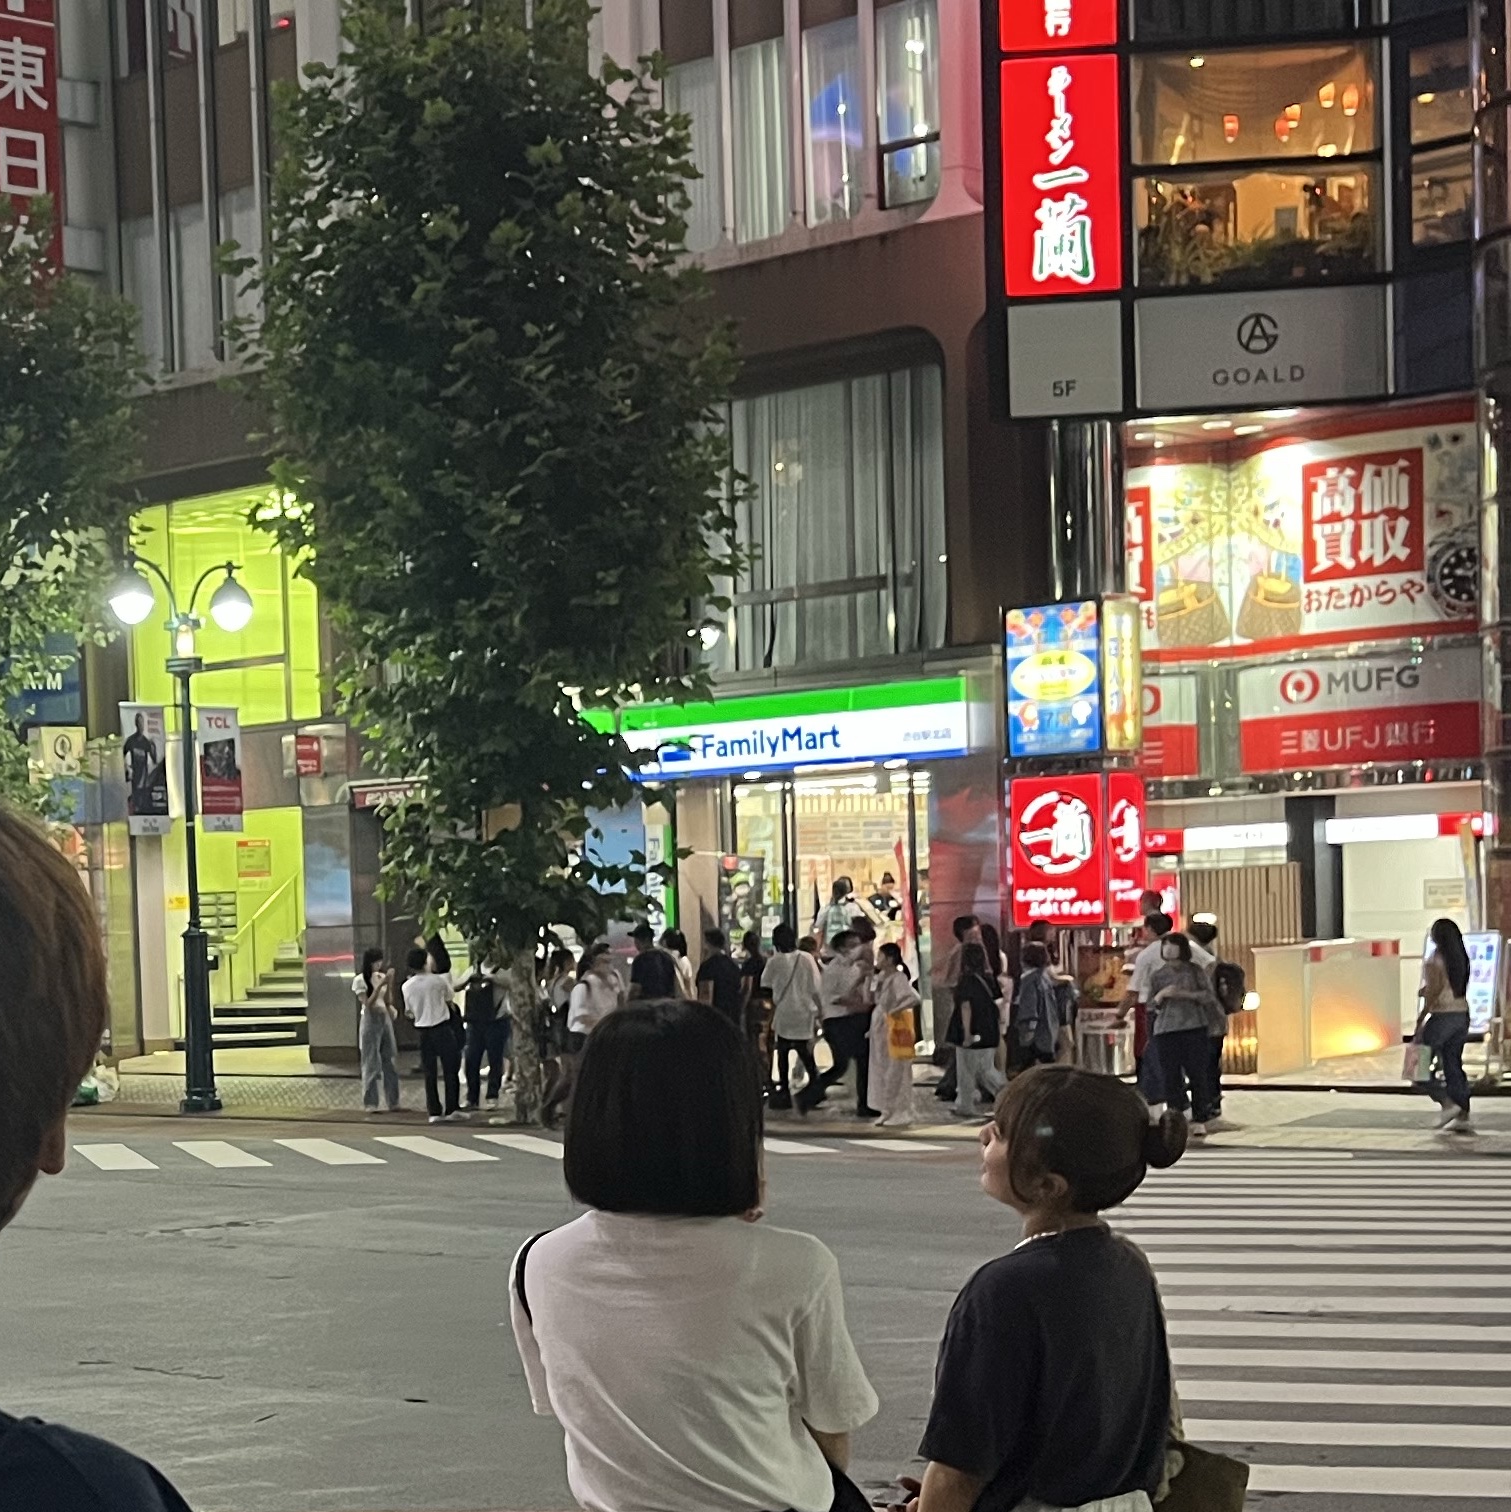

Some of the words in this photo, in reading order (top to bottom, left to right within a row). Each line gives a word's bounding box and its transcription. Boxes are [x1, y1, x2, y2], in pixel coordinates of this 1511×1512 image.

[1053, 381, 1077, 398] 5F
[1213, 365, 1305, 386] GOALD
[1309, 458, 1411, 521] 高価
[1309, 515, 1411, 575] 買取
[1304, 578, 1424, 614] おたからや
[1327, 664, 1420, 695] MUFG
[206, 716, 231, 730] TCL
[1279, 720, 1436, 755] 三菱UFJ銀行
[701, 724, 841, 758] FamilyMart
